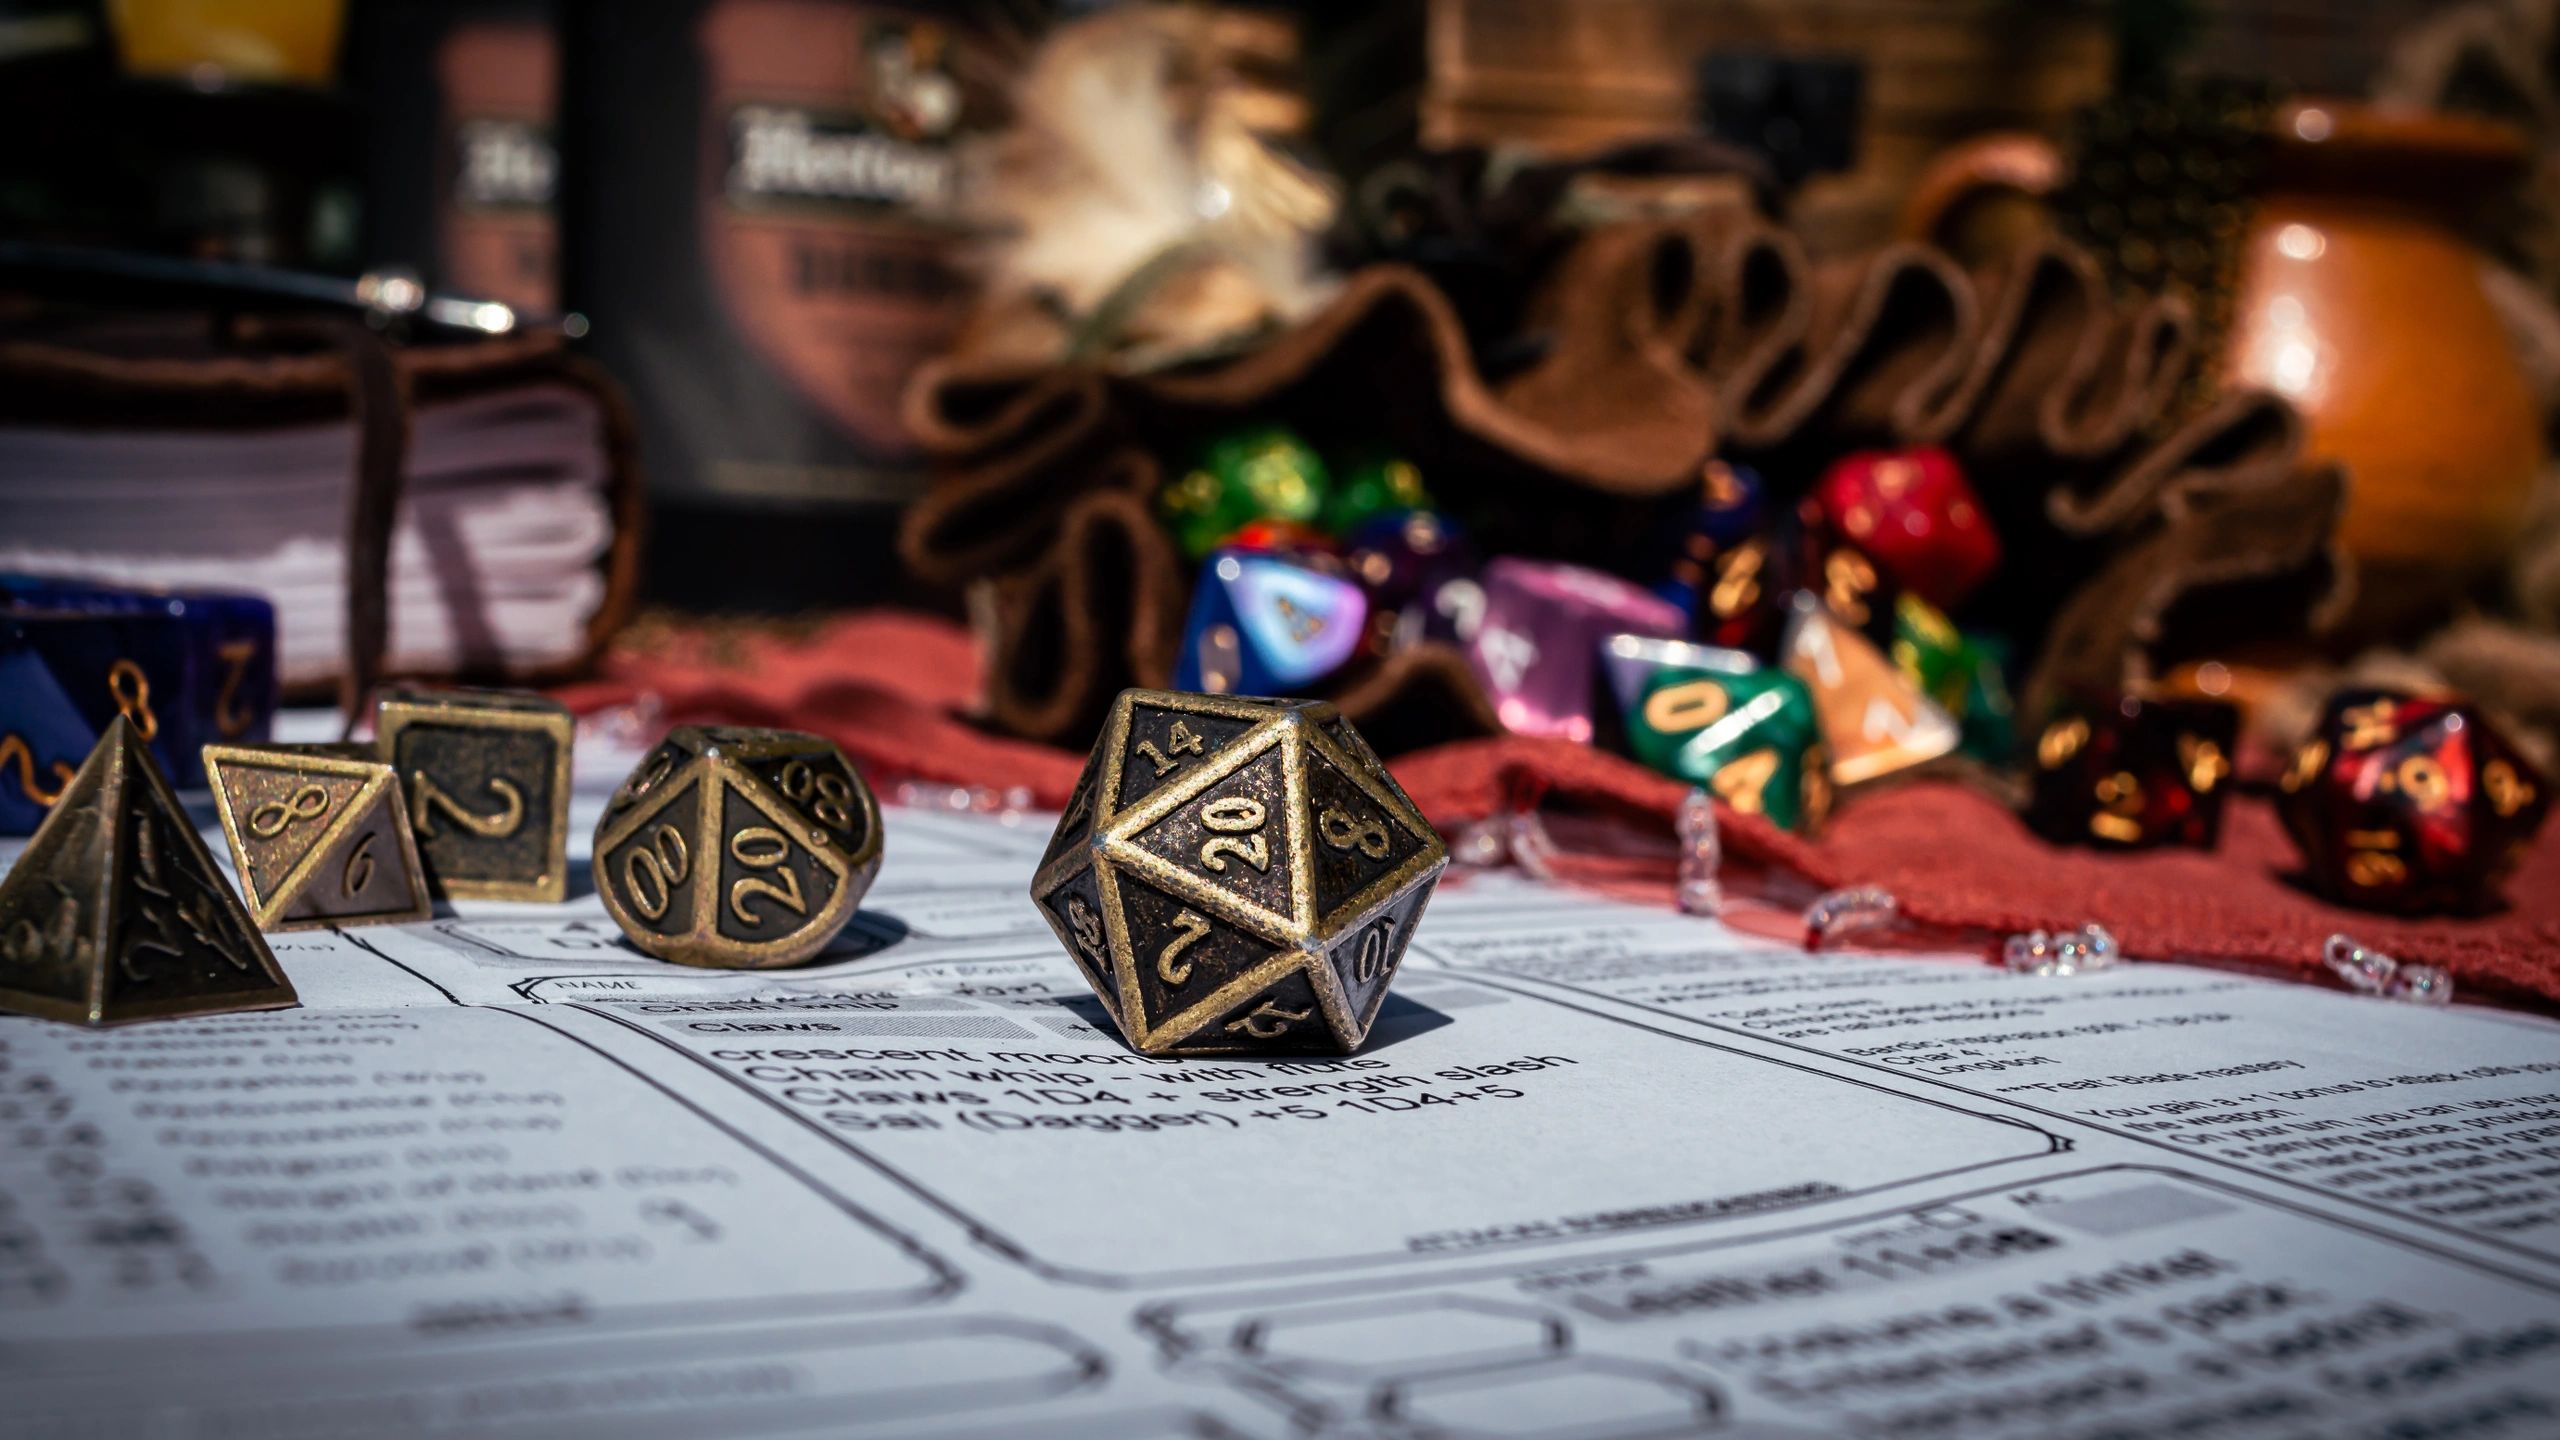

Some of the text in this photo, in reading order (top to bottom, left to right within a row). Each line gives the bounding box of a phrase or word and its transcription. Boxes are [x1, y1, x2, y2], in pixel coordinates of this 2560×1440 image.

[1135, 719, 1205, 778] 14
[249, 782, 331, 839] 8
[413, 770, 525, 840] 2
[1199, 797, 1270, 874] 20
[1318, 803, 1392, 862] 8
[342, 830, 377, 899] 6
[625, 824, 688, 921] 00
[730, 826, 806, 924] 20
[1154, 908, 1213, 986] 2
[1358, 915, 1397, 985] 10
[554, 980, 643, 990] NAME
[640, 1001, 900, 1013] Chain whip
[688, 1022, 842, 1033] Claws
[1777, 1027, 1830, 1039] are
[1842, 1040, 1944, 1057] Bardic
[710, 1048, 1185, 1066] crescent moons
[744, 1065, 941, 1083] Chain
[947, 1067, 1095, 1087] whip
[1139, 1067, 1266, 1085] with
[1266, 1058, 1391, 1077] flute
[783, 1055, 1580, 1106] Claws 1D4 + strength slash
[1880, 1051, 1959, 1065] Char
[2107, 1072, 2199, 1087] Blade
[2194, 1059, 2307, 1080] mastery
[956, 1109, 1240, 1133] (Dagger)
[1250, 1104, 1329, 1121] +5
[1335, 1084, 1526, 1114] 1D4+5
[2075, 1106, 2153, 1120] You
[2147, 1099, 2218, 1116] gain
[2212, 1098, 2241, 1107] a
[2238, 1092, 2279, 1104] +1
[2272, 1081, 2365, 1101] bonus
[2354, 1077, 2394, 1090] to
[2389, 1072, 2473, 1086] attack
[2122, 1108, 2305, 1133] the weapon.
[2168, 1133, 2230, 1146] On
[2220, 1125, 2294, 1142] your
[2352, 1110, 2416, 1127] you
[2408, 1101, 2467, 1117] can
[2458, 1098, 2516, 1110] use
